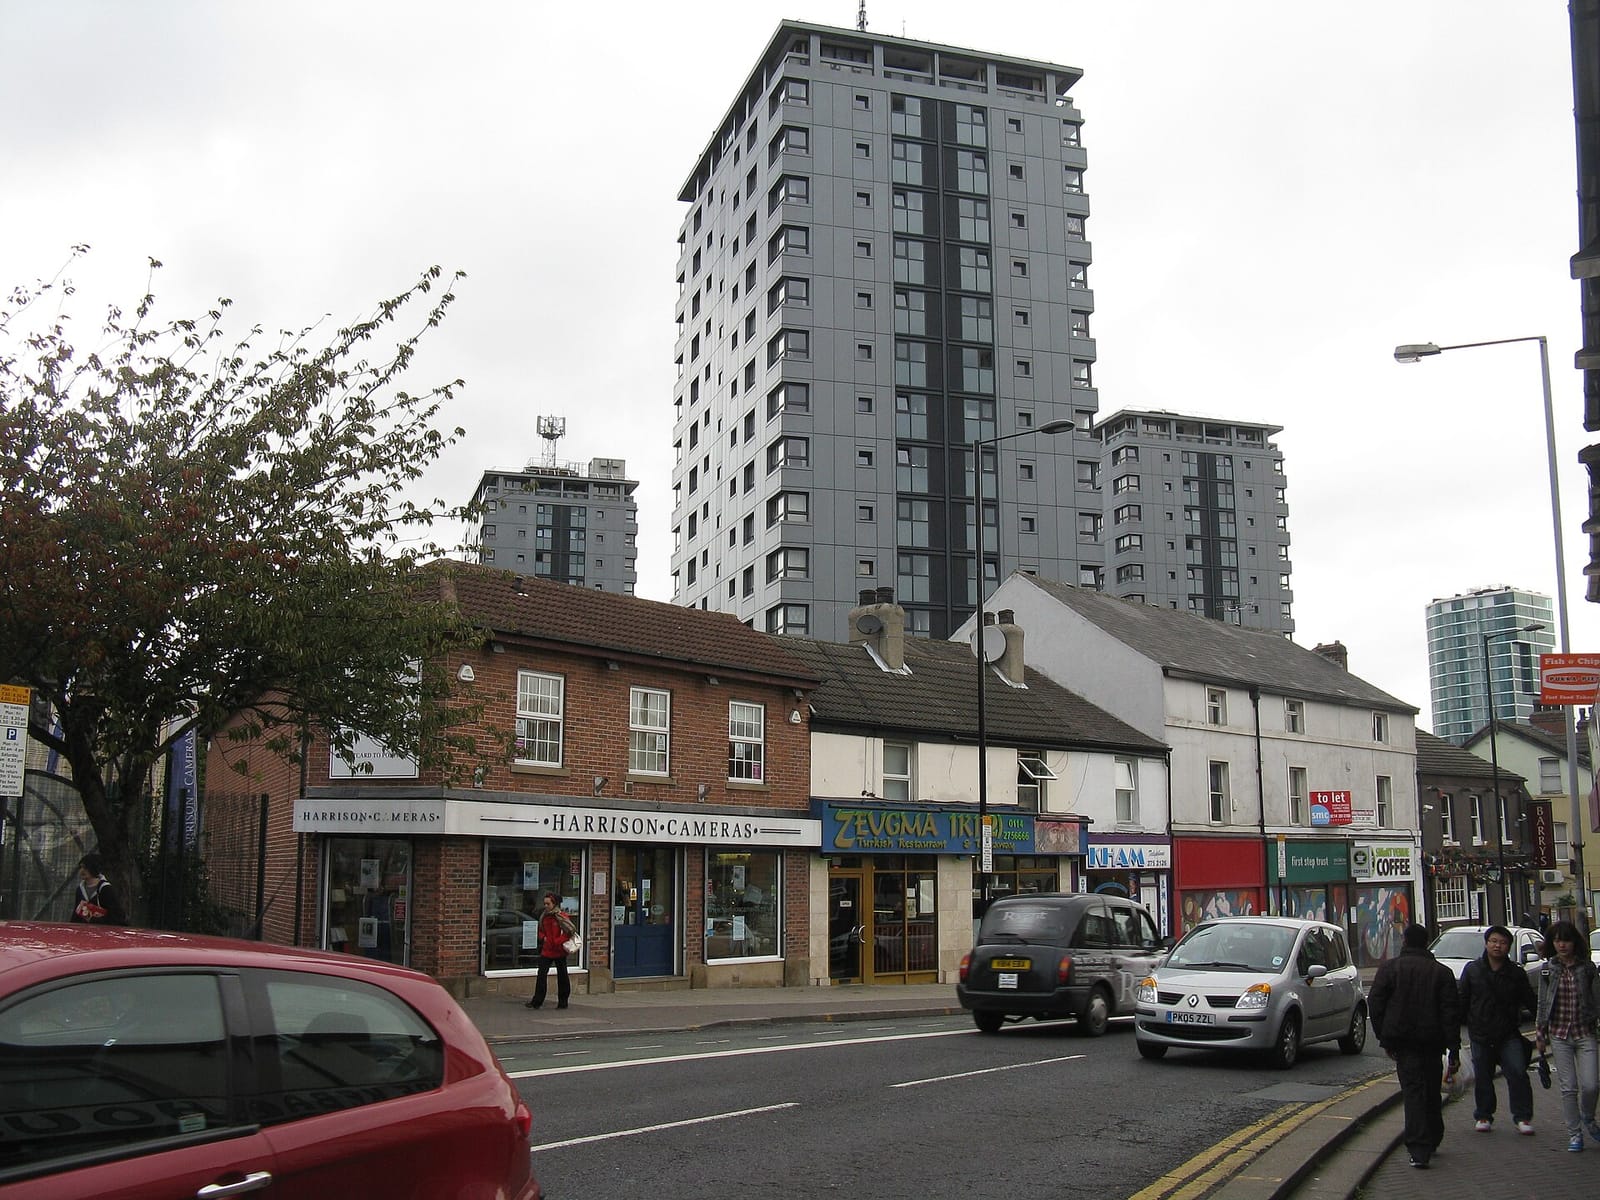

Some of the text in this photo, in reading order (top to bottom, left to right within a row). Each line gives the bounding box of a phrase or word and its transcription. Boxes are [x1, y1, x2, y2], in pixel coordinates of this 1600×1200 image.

[1577, 657, 1600, 667] Chip
[9, 729, 16, 739] P
[184, 730, 194, 786] CAMERAS
[1317, 792, 1346, 803] to let
[303, 811, 436, 823] HARRISON CMERAS
[552, 813, 753, 840] HARRISON CAMERAS
[1008, 819, 1023, 829] 0114
[856, 837, 893, 849] Turkish
[899, 839, 947, 850] Restaurant
[1291, 855, 1303, 867] First
[1304, 857, 1316, 869] step
[1316, 857, 1329, 867] trust
[1376, 858, 1411, 877] COFFEE
